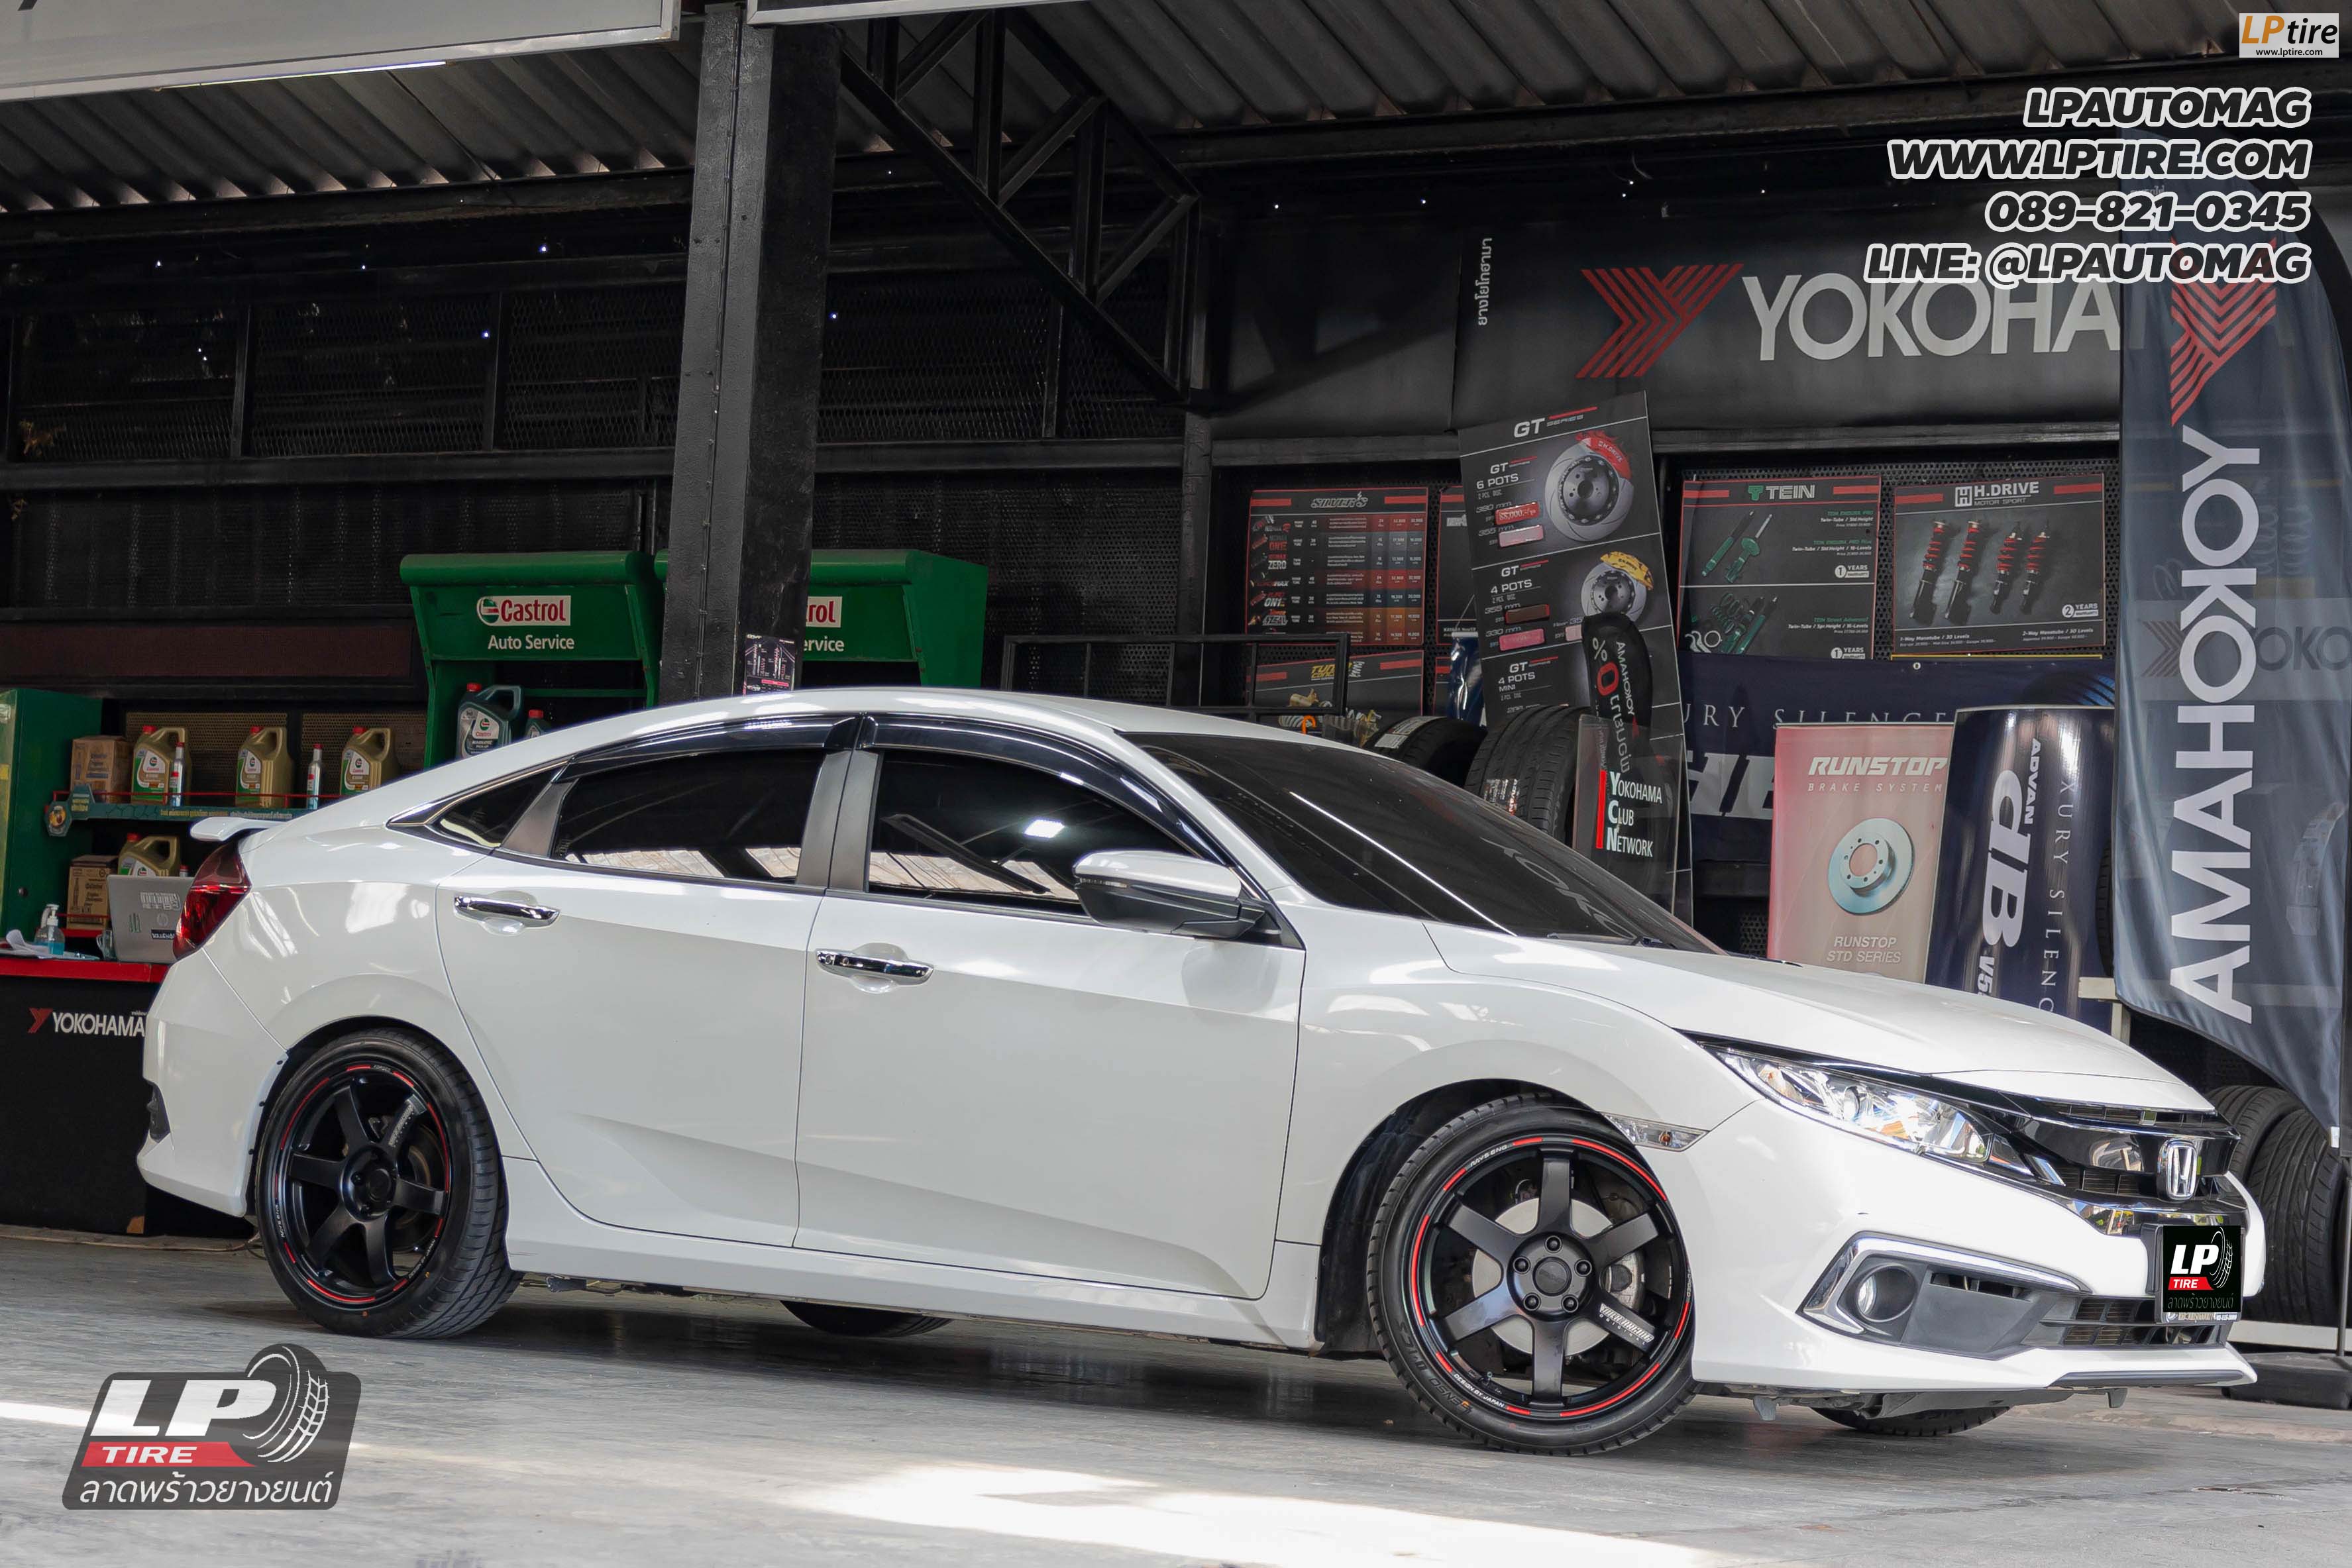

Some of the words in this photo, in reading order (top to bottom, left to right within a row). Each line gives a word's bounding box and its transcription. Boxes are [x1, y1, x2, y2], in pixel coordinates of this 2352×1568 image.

[1478, 237, 1493, 326] ยางโยโกฮามา
[1742, 266, 2121, 362] YOKOHA
[1514, 417, 1545, 438] GT
[1490, 462, 1509, 474] GT
[1476, 480, 1484, 490] 6
[1488, 474, 1519, 488] POTS
[1974, 482, 2039, 497] H.DRIVE
[1766, 485, 1815, 499] TEIN
[1267, 560, 1287, 570] ZERO
[1501, 565, 1519, 577] GT
[1501, 579, 1532, 593] POTS
[501, 600, 566, 623] Castrol
[488, 635, 522, 650] Auto
[525, 634, 575, 650] Service
[803, 637, 845, 652] ervice
[2255, 626, 2352, 671] OKO
[1509, 662, 1528, 673] GT
[1508, 672, 1536, 683] POTS
[1808, 756, 1948, 776] RUNSTOP
[1609, 771, 1663, 804] YOKOHAMA
[1808, 782, 1860, 792] BRAKE
[1876, 782, 1943, 793] SYSTEM
[2023, 737, 2042, 825] ADVAN
[1982, 770, 2032, 949] dB
[1834, 935, 1898, 949] RUNSTOP
[2039, 888, 2066, 1012] SILENC
[1827, 951, 1853, 963] STD
[1855, 951, 1902, 964] SERIES
[52, 1011, 146, 1037] YOKOHAMA
[1599, 1313, 1646, 1345] ORIGINAL
[1454, 1373, 1475, 1391] DESIGN
[1483, 1396, 1505, 1408] JAPAN
